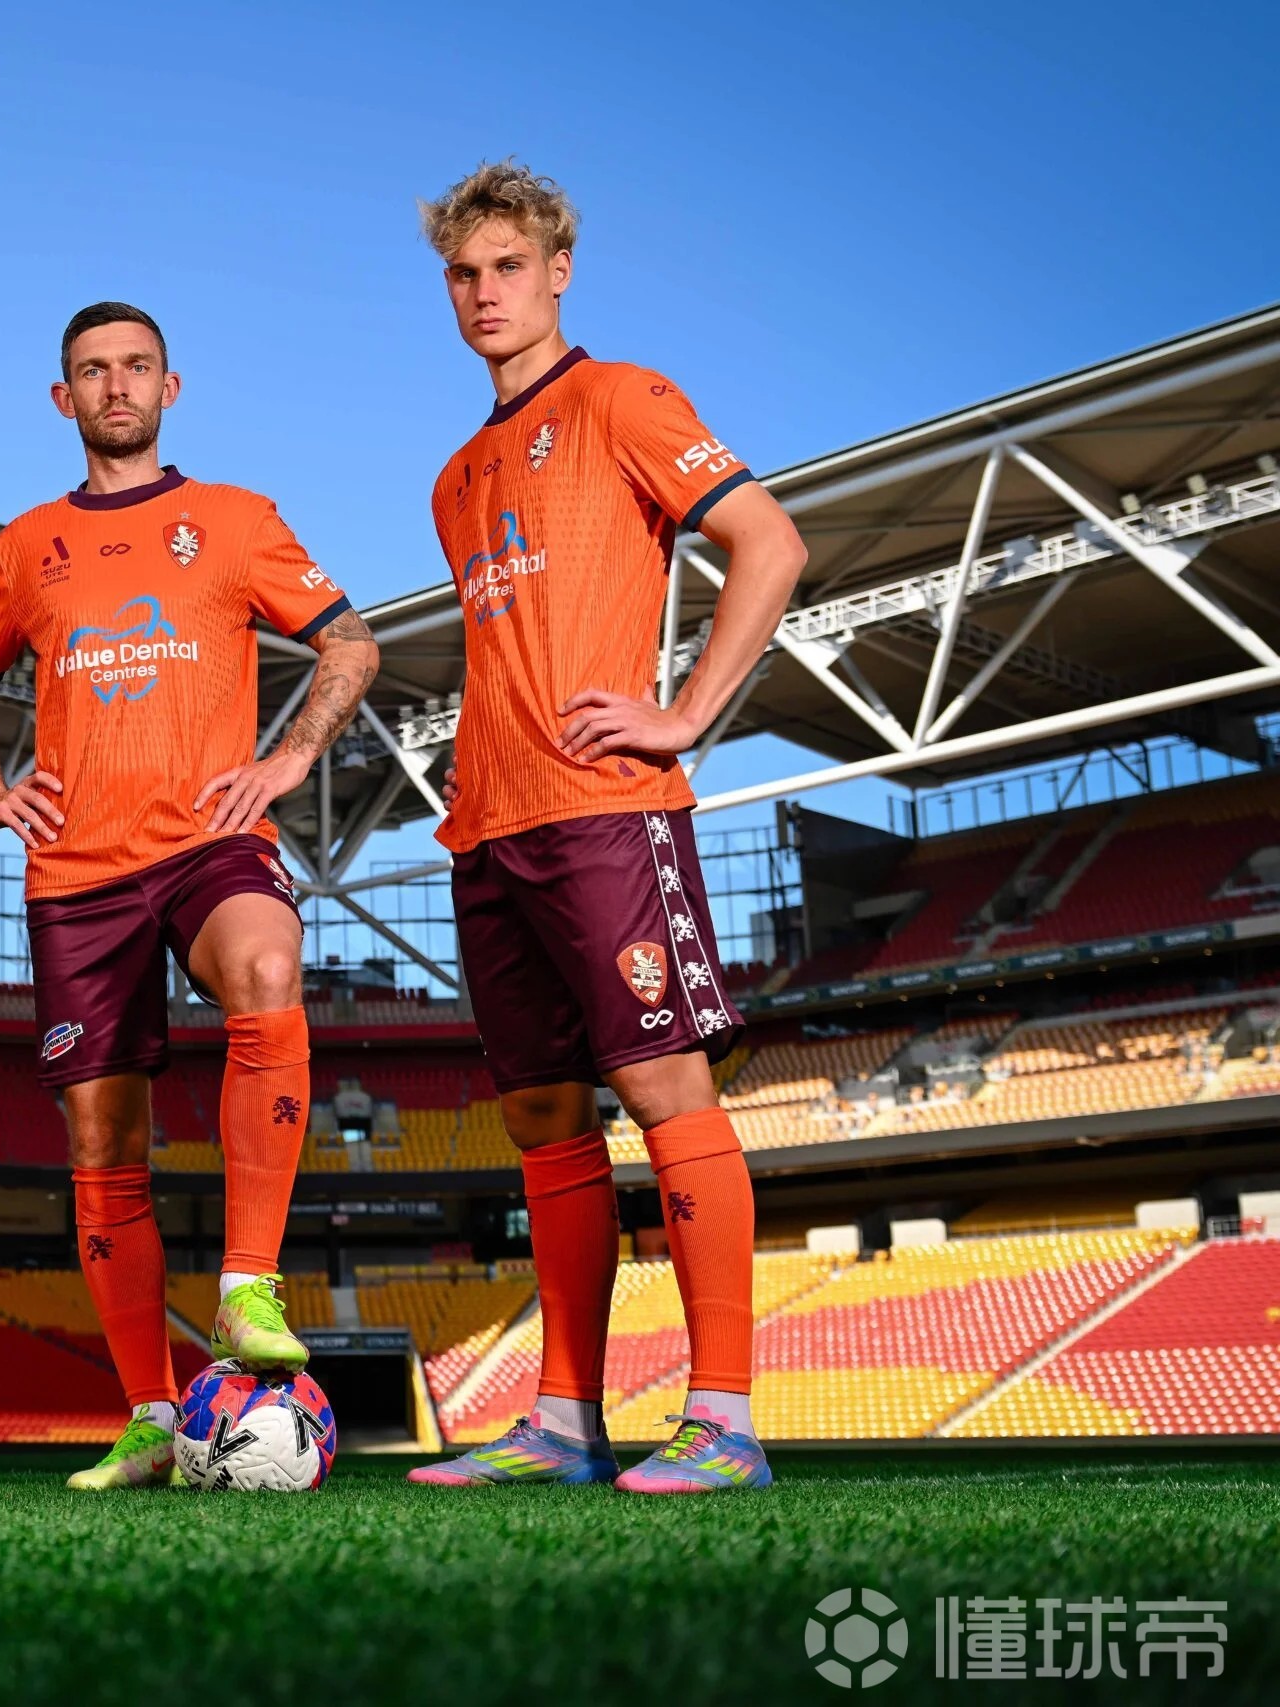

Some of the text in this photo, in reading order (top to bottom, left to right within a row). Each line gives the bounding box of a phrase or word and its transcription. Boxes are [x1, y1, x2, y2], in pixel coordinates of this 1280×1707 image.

[675, 438, 729, 475] ISU
[707, 453, 738, 474] UT
[40, 563, 71, 577] ISUZU
[486, 548, 546, 583] Dental
[54, 640, 199, 678] Value Dental
[90, 664, 157, 684] Centres
